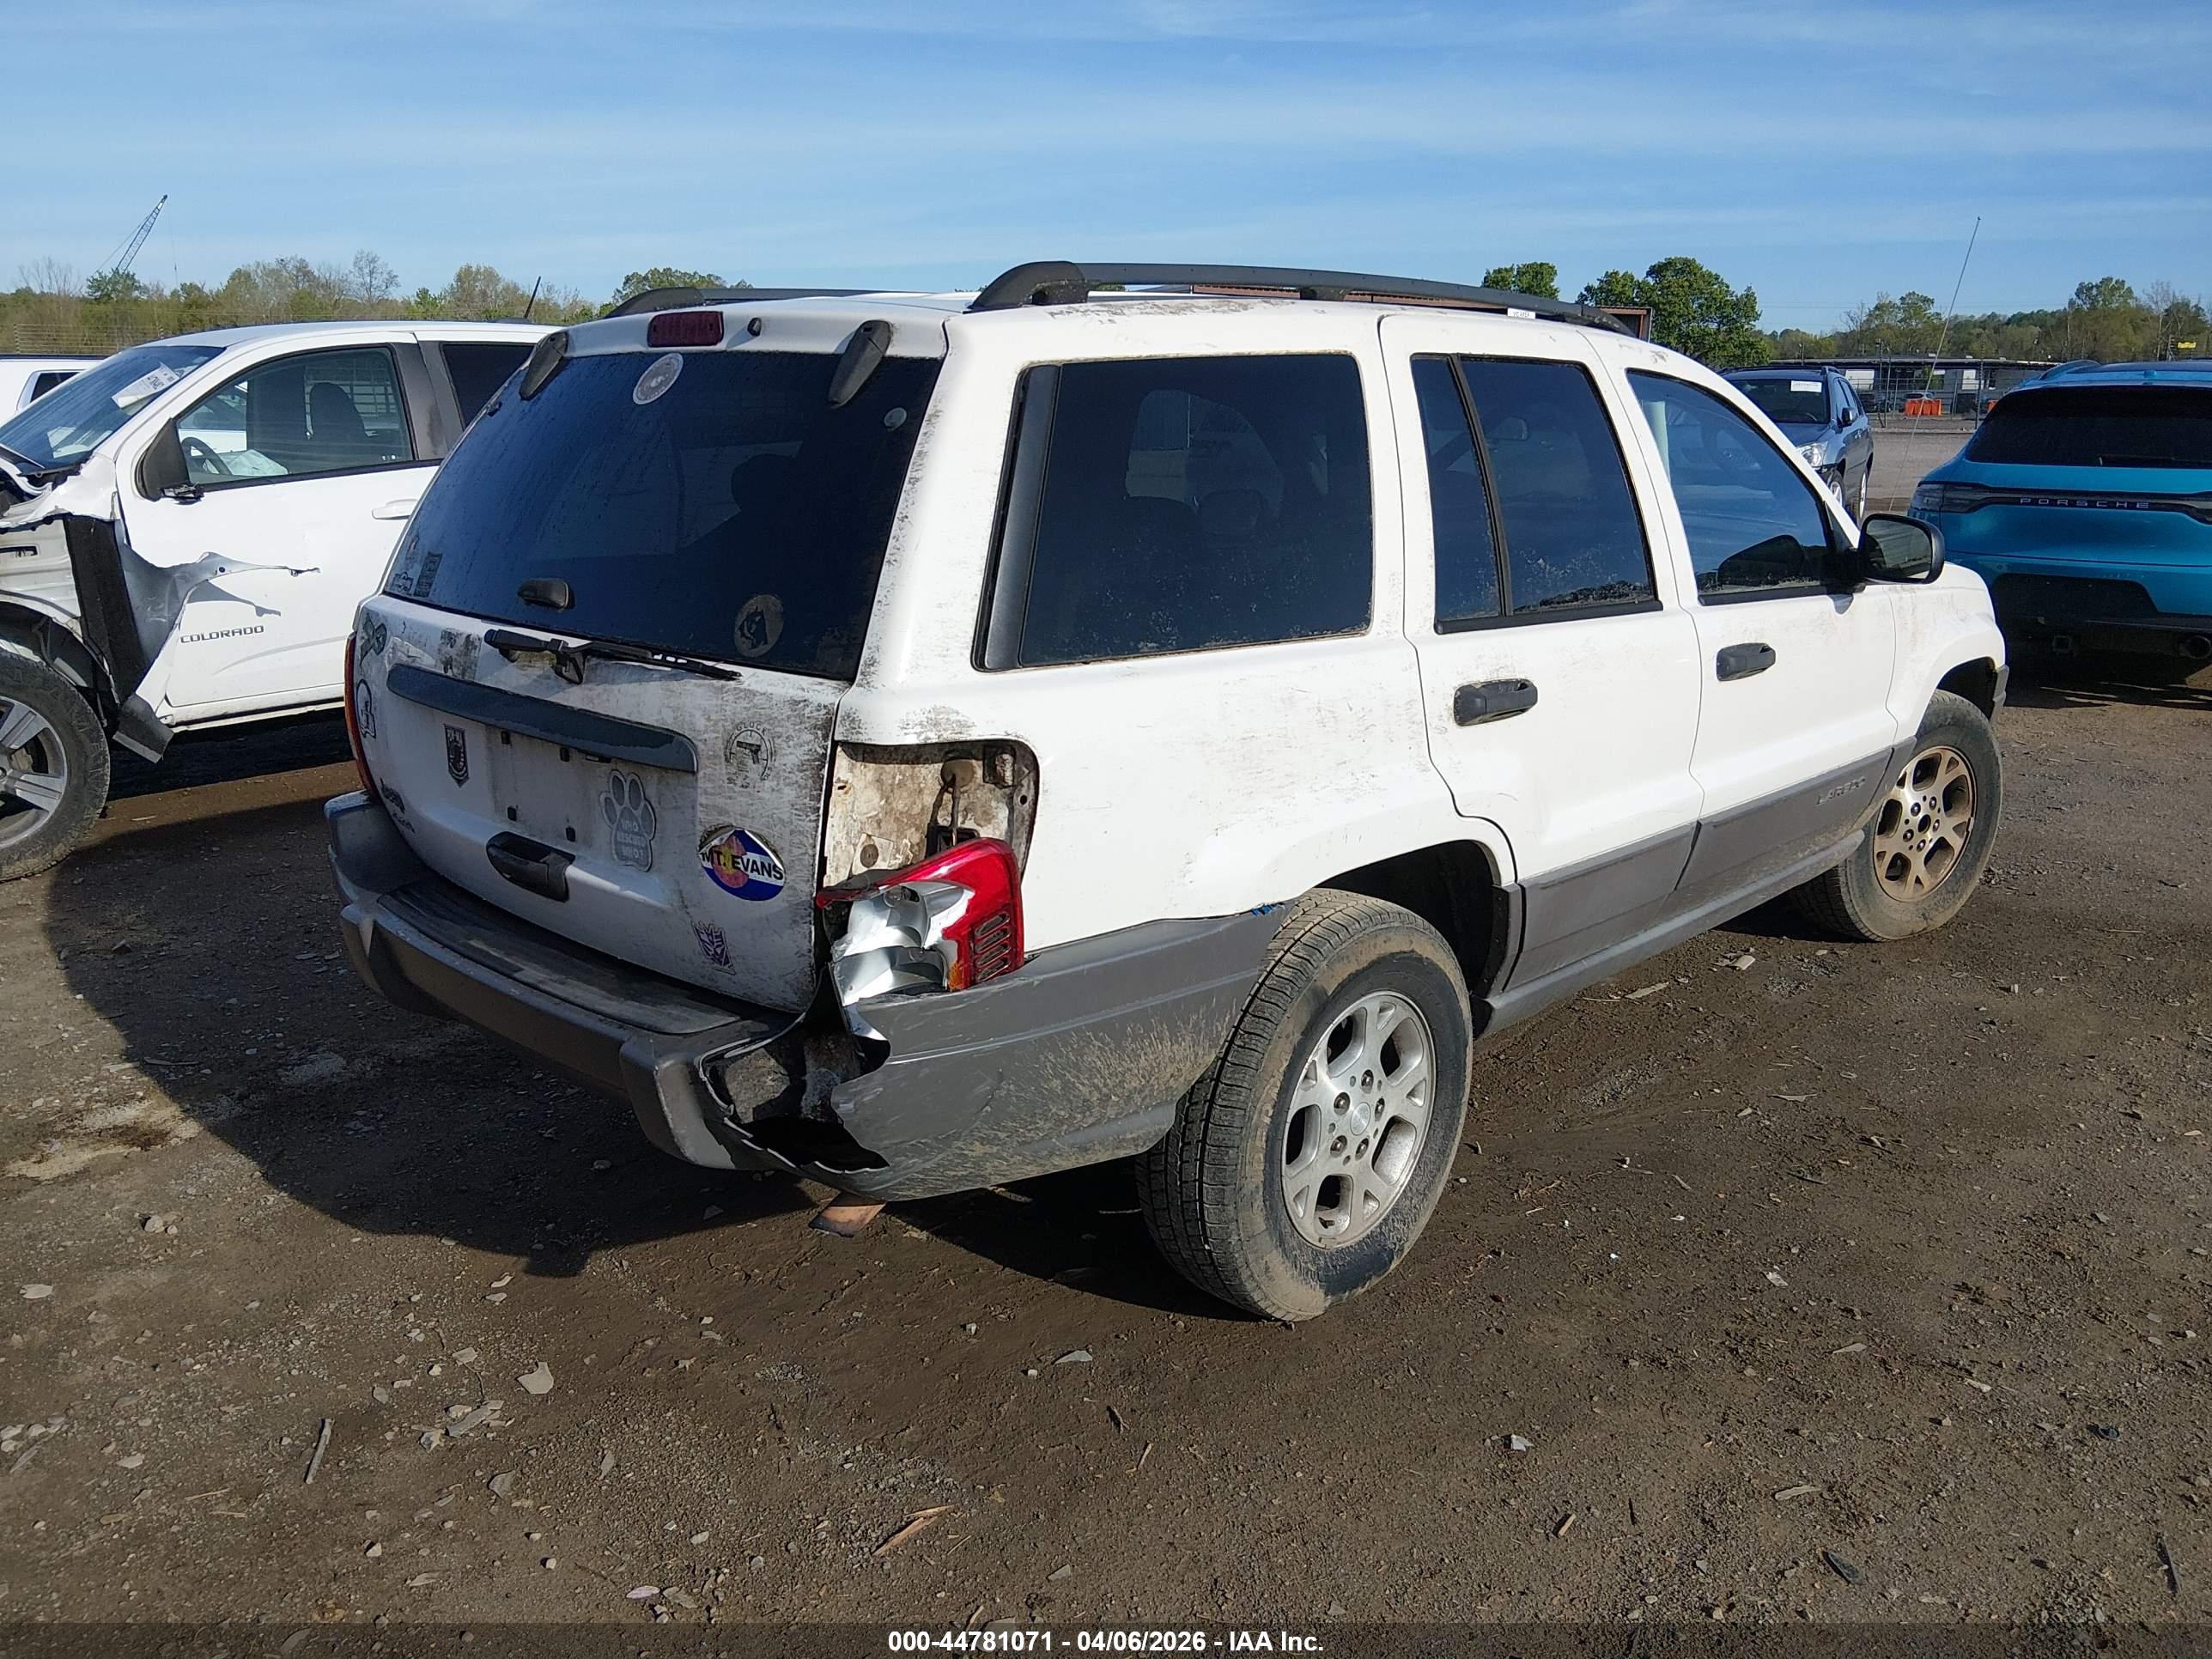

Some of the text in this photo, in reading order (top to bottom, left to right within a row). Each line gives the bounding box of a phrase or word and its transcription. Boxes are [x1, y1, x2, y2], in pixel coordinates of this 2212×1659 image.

[2020, 498, 2149, 508] PORSCHE
[180, 625, 264, 643] COLORADO
[732, 854, 784, 880] EVANS
